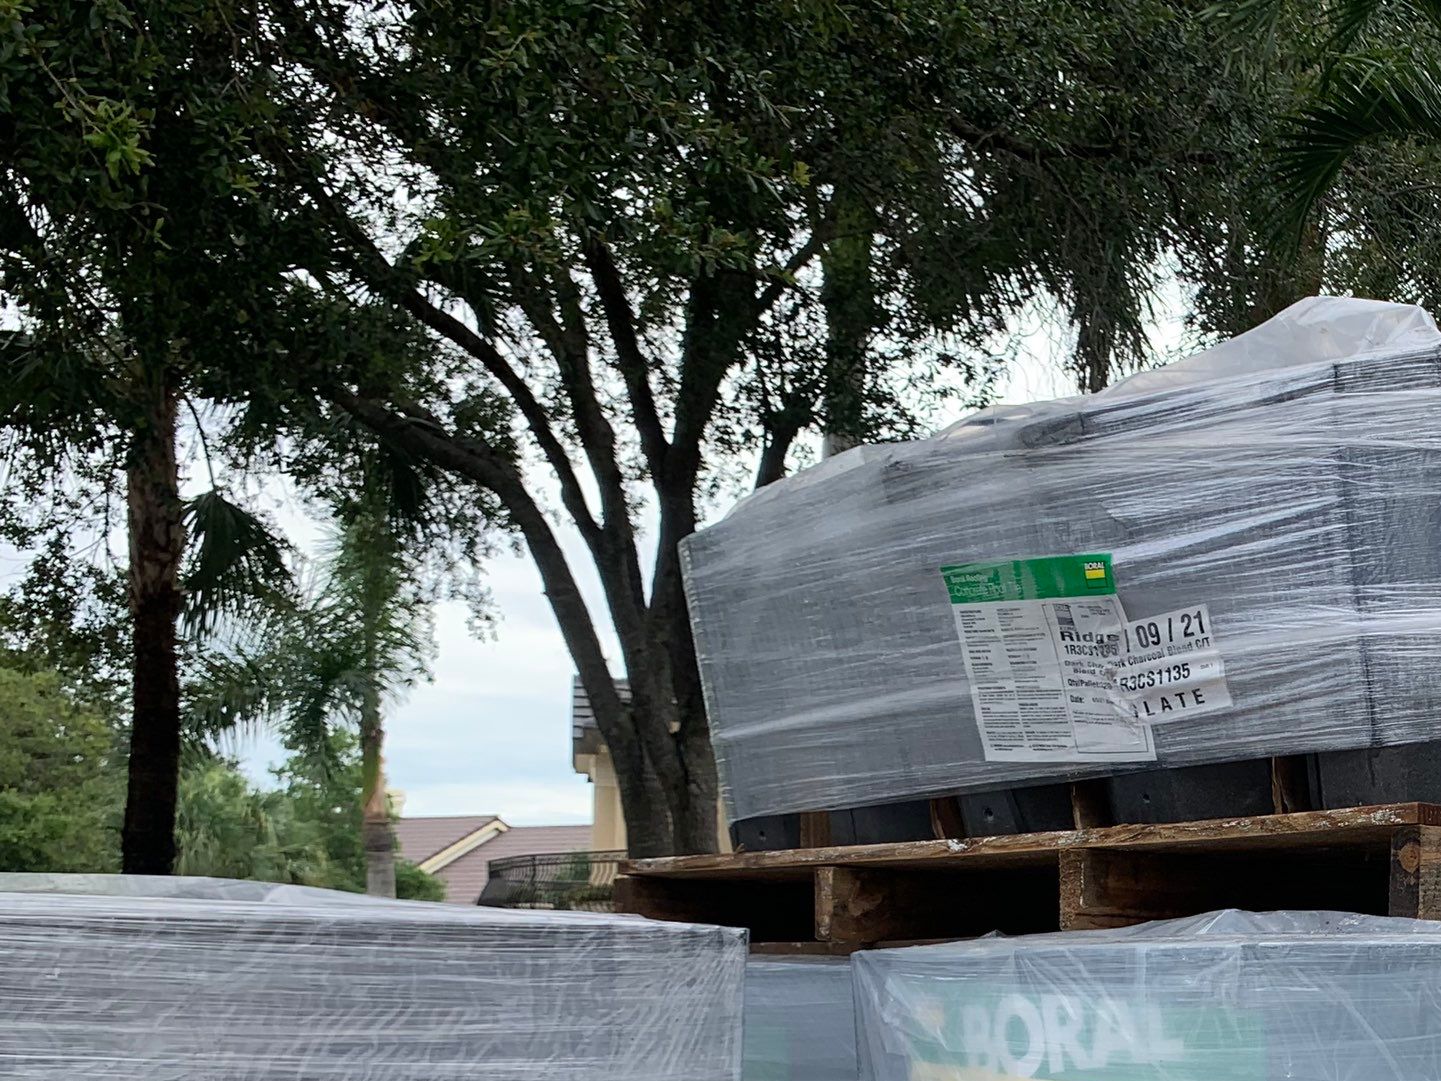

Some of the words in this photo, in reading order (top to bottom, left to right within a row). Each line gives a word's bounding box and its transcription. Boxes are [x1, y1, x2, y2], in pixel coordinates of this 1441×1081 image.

[1060, 631, 1120, 645] Ridge
[1135, 622, 1161, 649] 09
[1180, 610, 1206, 638] 21
[1128, 650, 1166, 666] Charcoal
[1168, 641, 1193, 656] Blend
[1116, 662, 1191, 693] R3CS1135
[962, 993, 1185, 1079] BORAL
